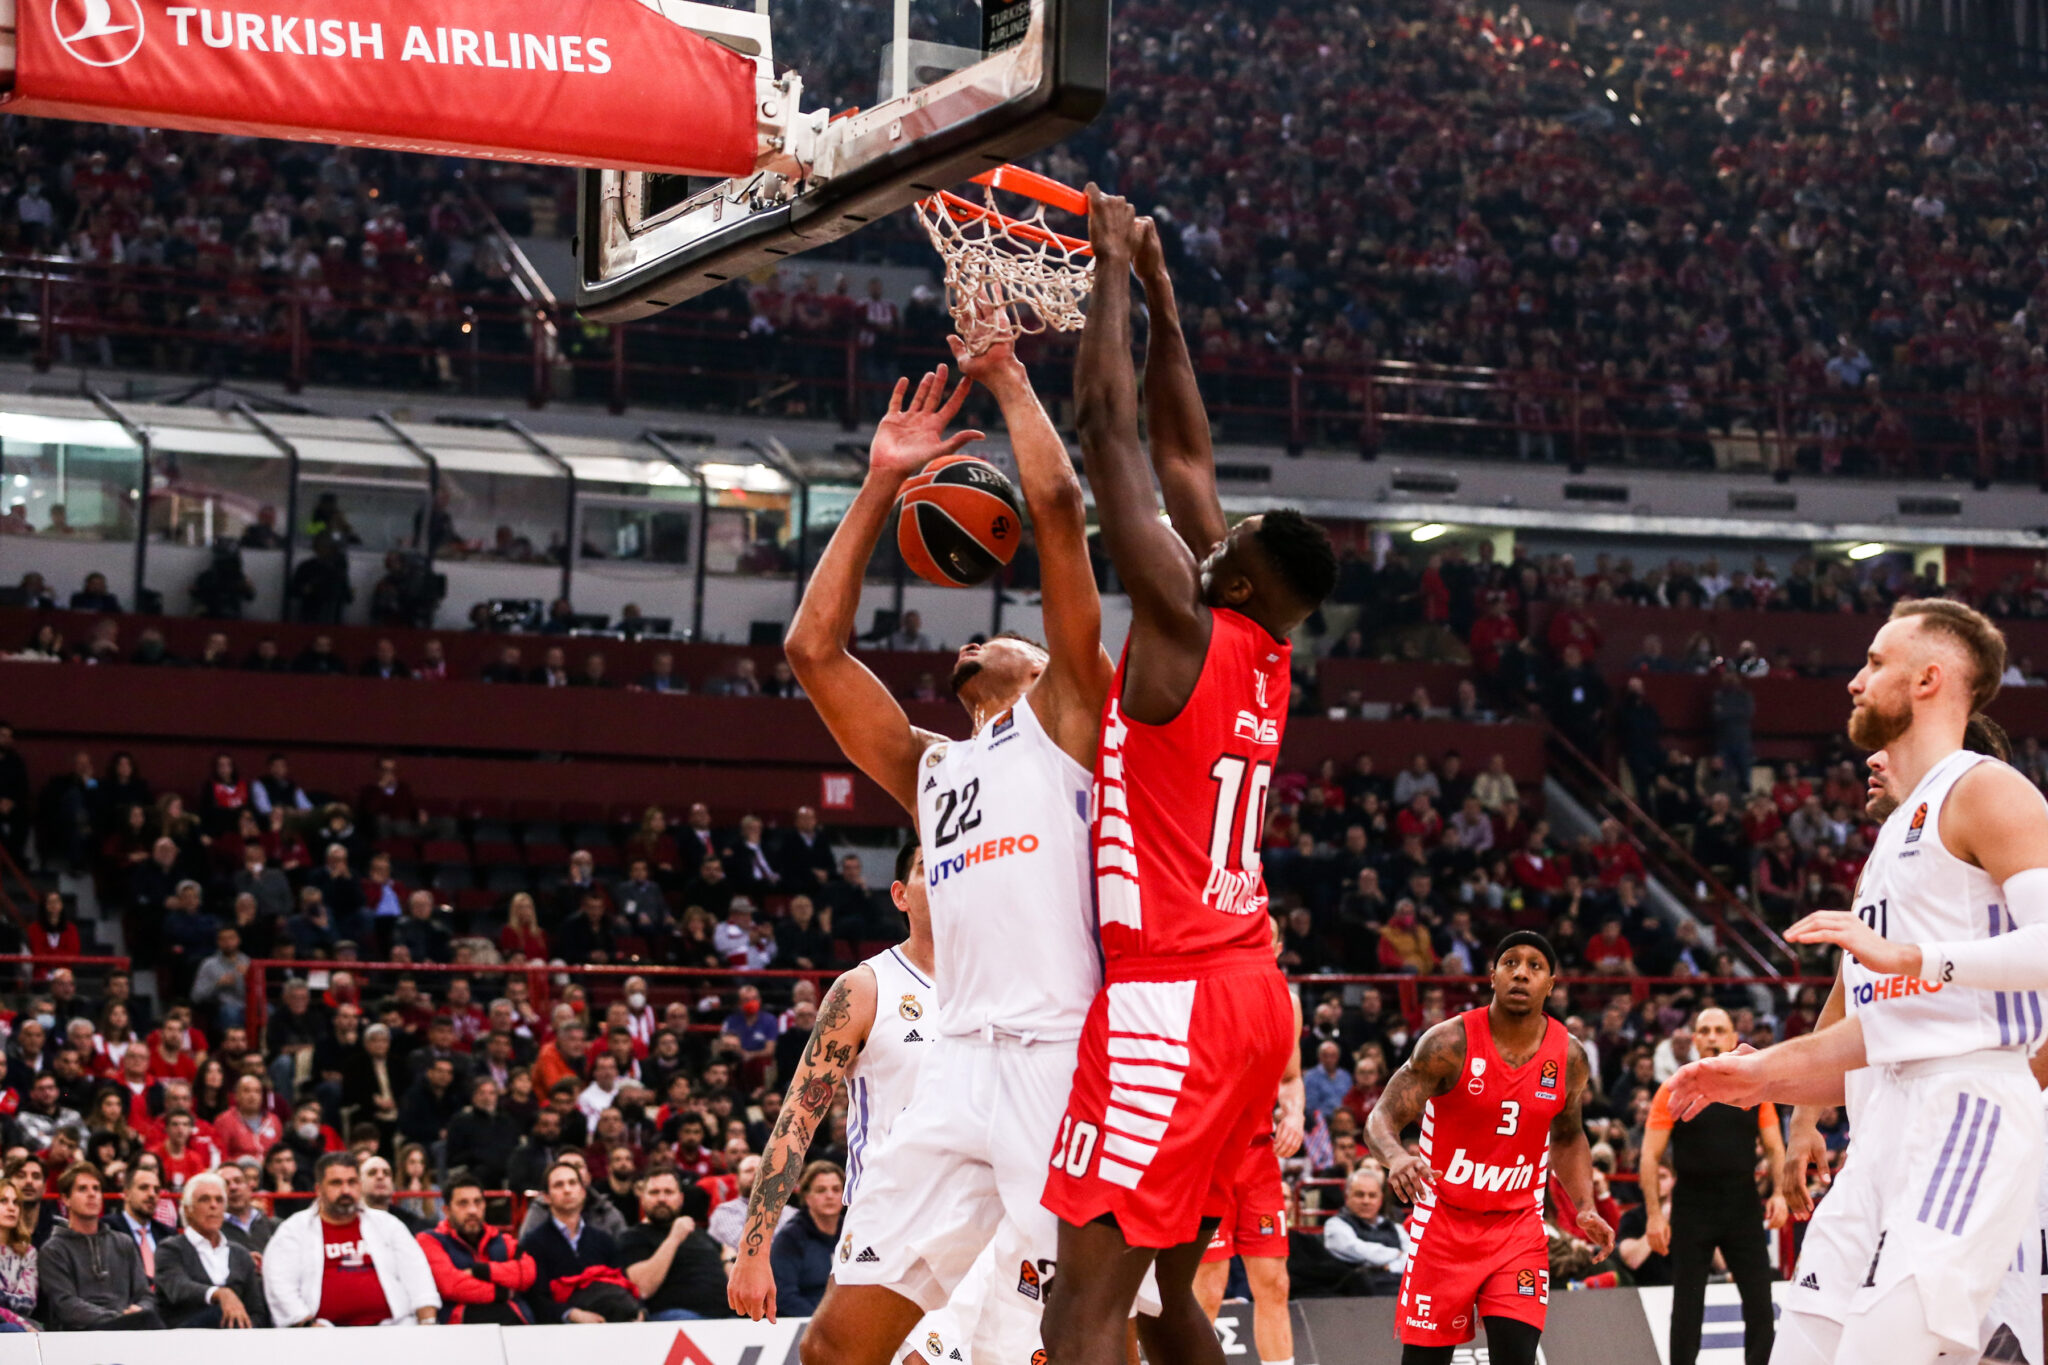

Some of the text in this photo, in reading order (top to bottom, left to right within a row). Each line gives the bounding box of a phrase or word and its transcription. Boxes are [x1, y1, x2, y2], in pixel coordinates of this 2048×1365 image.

[166, 7, 612, 74] TURKISH AIRLINES
[826, 777, 851, 804] VIP
[935, 777, 982, 848] 22
[1210, 753, 1271, 872] 10
[929, 834, 1039, 888] UTOHERO
[824, 1040, 852, 1068] 14
[1496, 1101, 1520, 1136] 3
[1050, 1114, 1098, 1179] 10
[1444, 1148, 1534, 1192] bwin
[1538, 1269, 1550, 1305] 3
[1406, 1316, 1438, 1331] FlexCar
